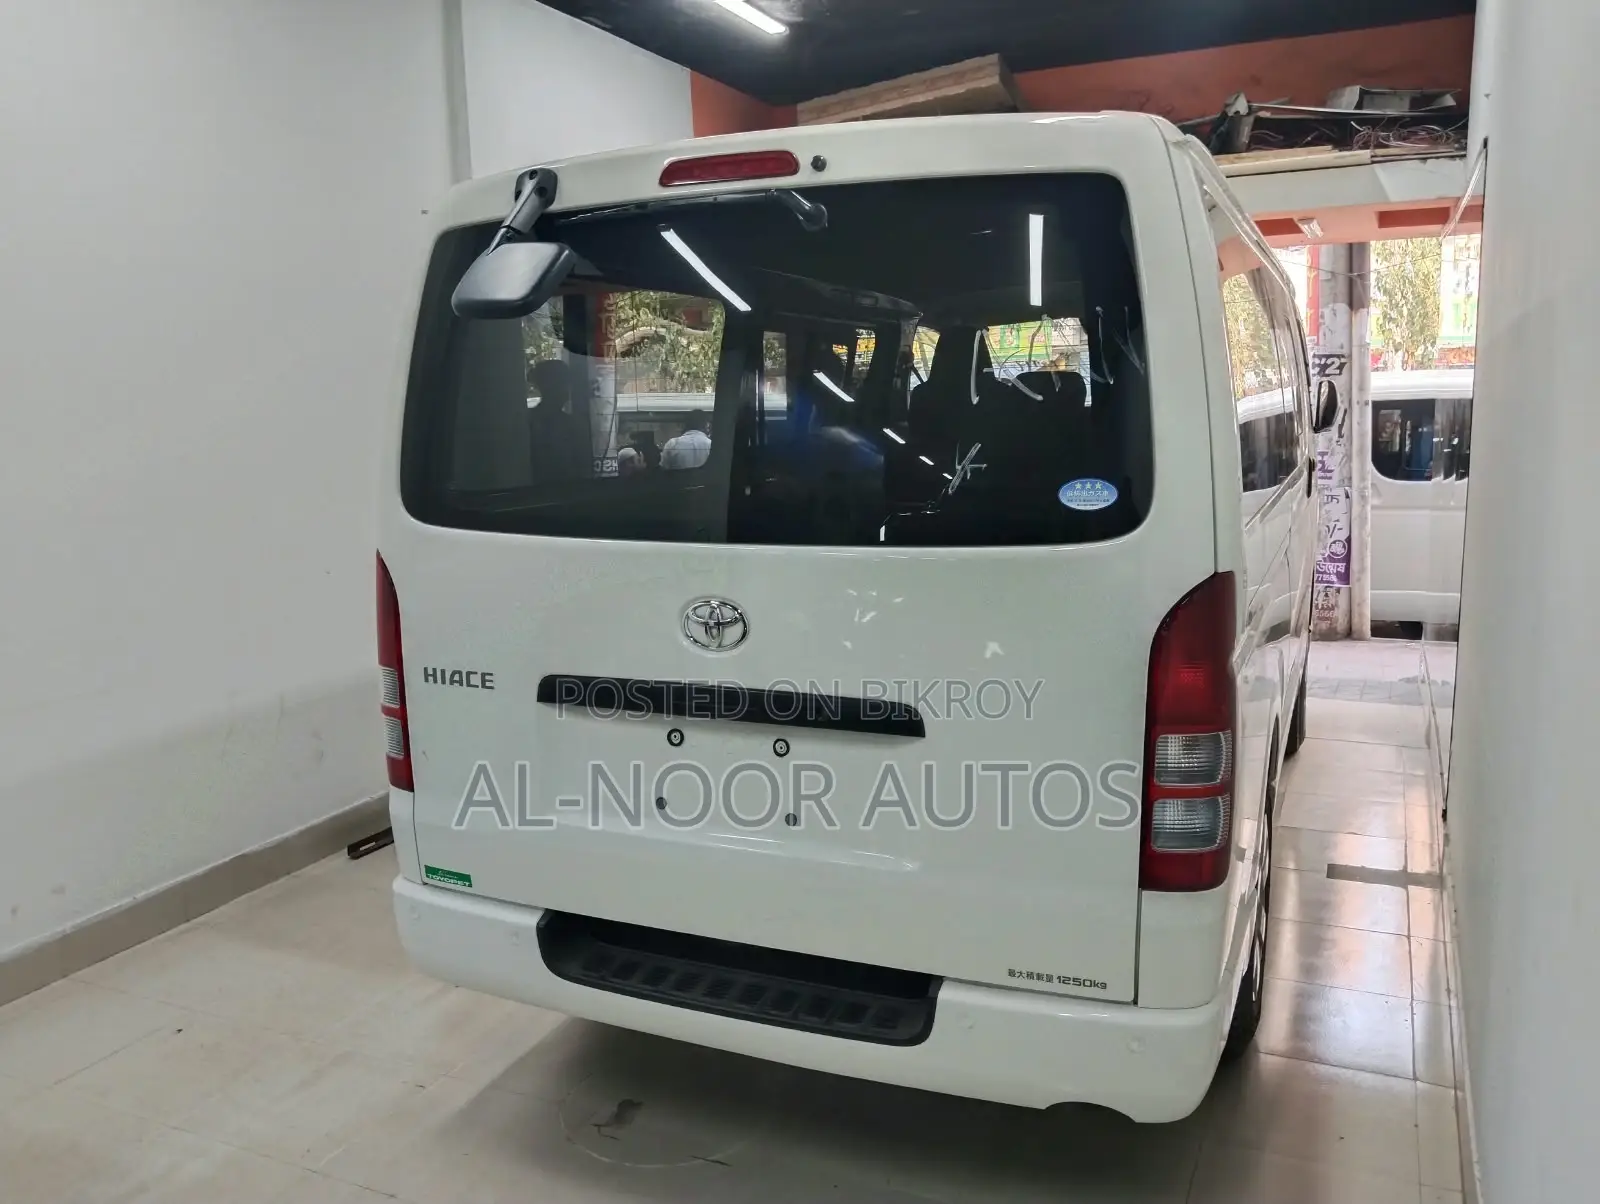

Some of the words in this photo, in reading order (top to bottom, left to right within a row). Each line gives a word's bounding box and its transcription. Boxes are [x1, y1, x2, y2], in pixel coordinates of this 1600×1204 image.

[423, 666, 495, 690] HIACE
[427, 873, 470, 887] TOYOPET
[1056, 975, 1107, 990] 1250kg
